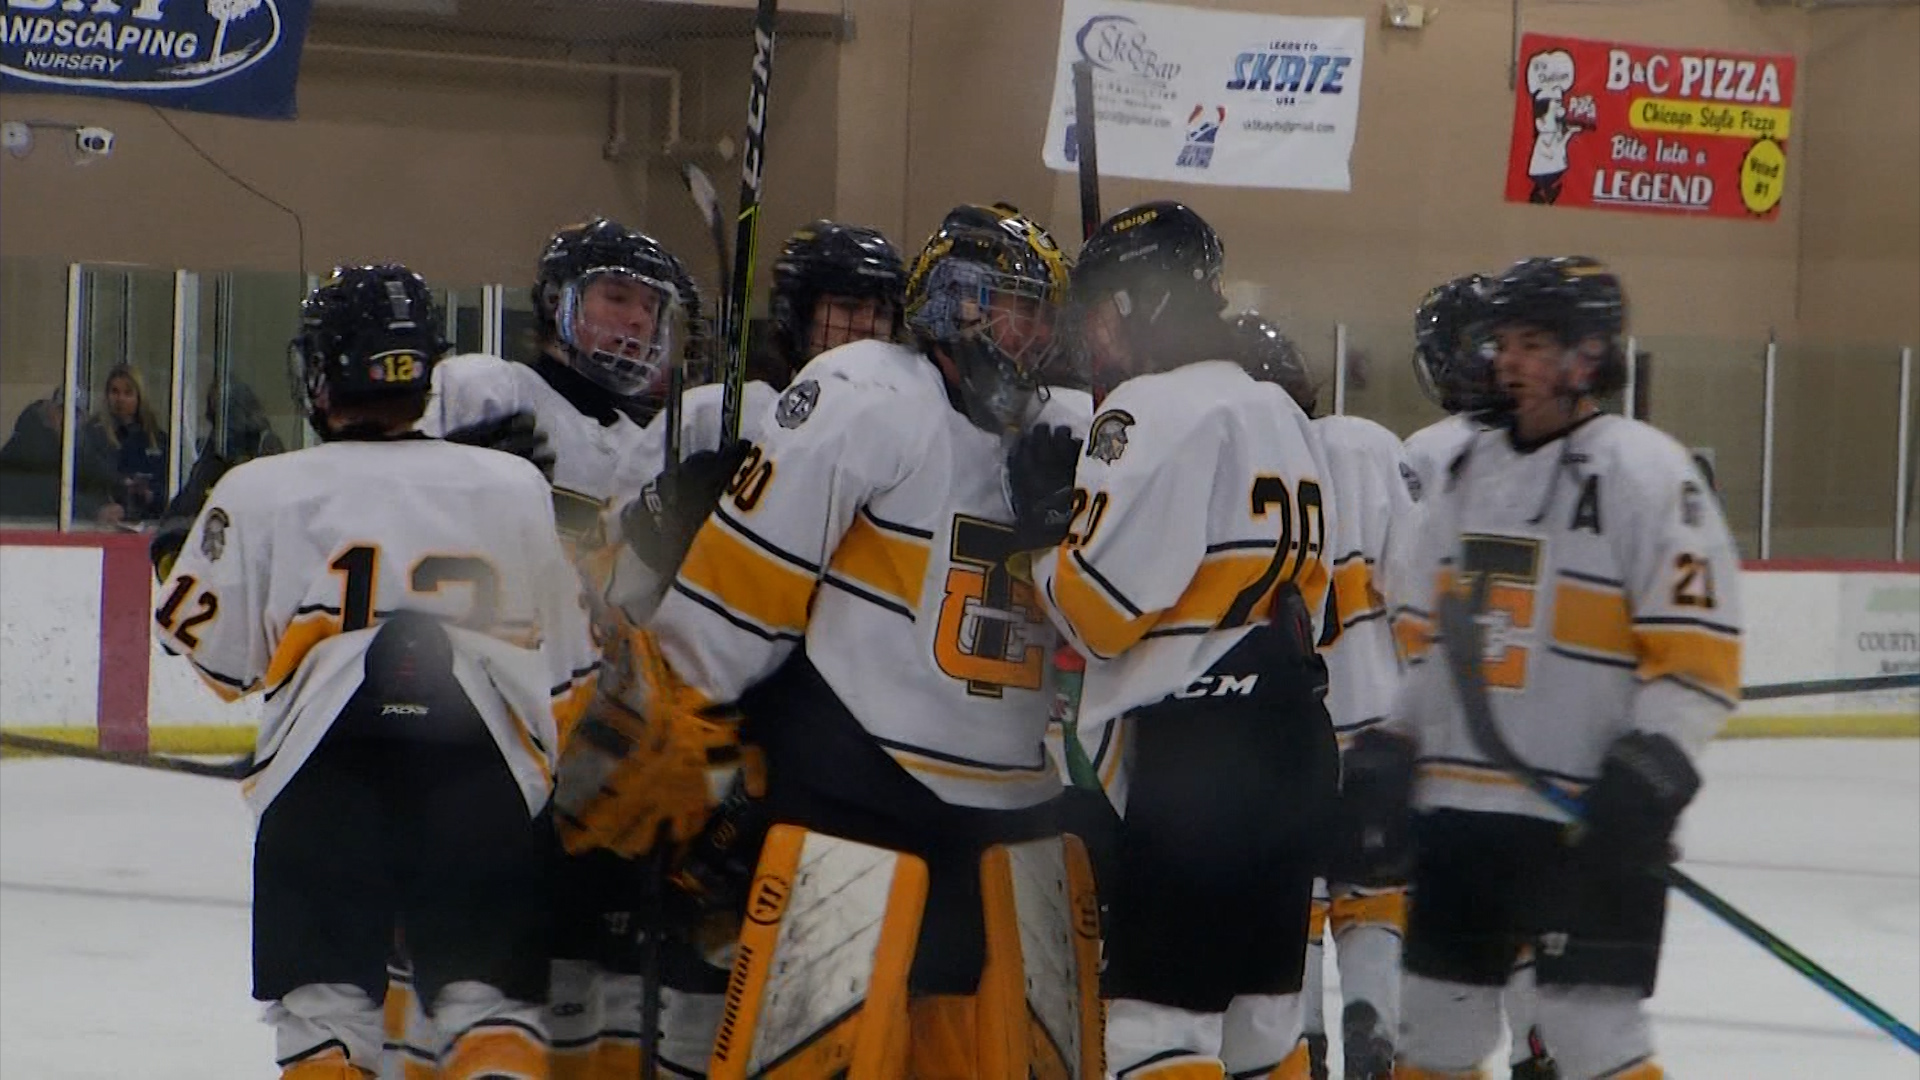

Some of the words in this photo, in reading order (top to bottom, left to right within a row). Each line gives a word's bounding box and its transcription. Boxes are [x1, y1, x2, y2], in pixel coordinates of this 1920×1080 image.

[24, 51, 123, 73] NURSERY
[1226, 52, 1353, 94] SKATE
[1607, 50, 1670, 93] B&C
[1679, 56, 1781, 103] PIZZA
[742, 27, 772, 191] CCM
[1642, 102, 1694, 128] Chicago
[1699, 106, 1735, 132] Style
[1740, 110, 1777, 131] Pizza
[1611, 134, 1648, 161] Bite
[1656, 139, 1689, 165] Into
[1696, 151, 1706, 165] a
[1592, 169, 1714, 206] LEGEND
[383, 354, 414, 383] 12
[727, 445, 773, 512] 30
[1568, 473, 1602, 535] A
[1672, 553, 1716, 609] 21
[155, 573, 219, 650] 12
[1176, 672, 1260, 699] CM
